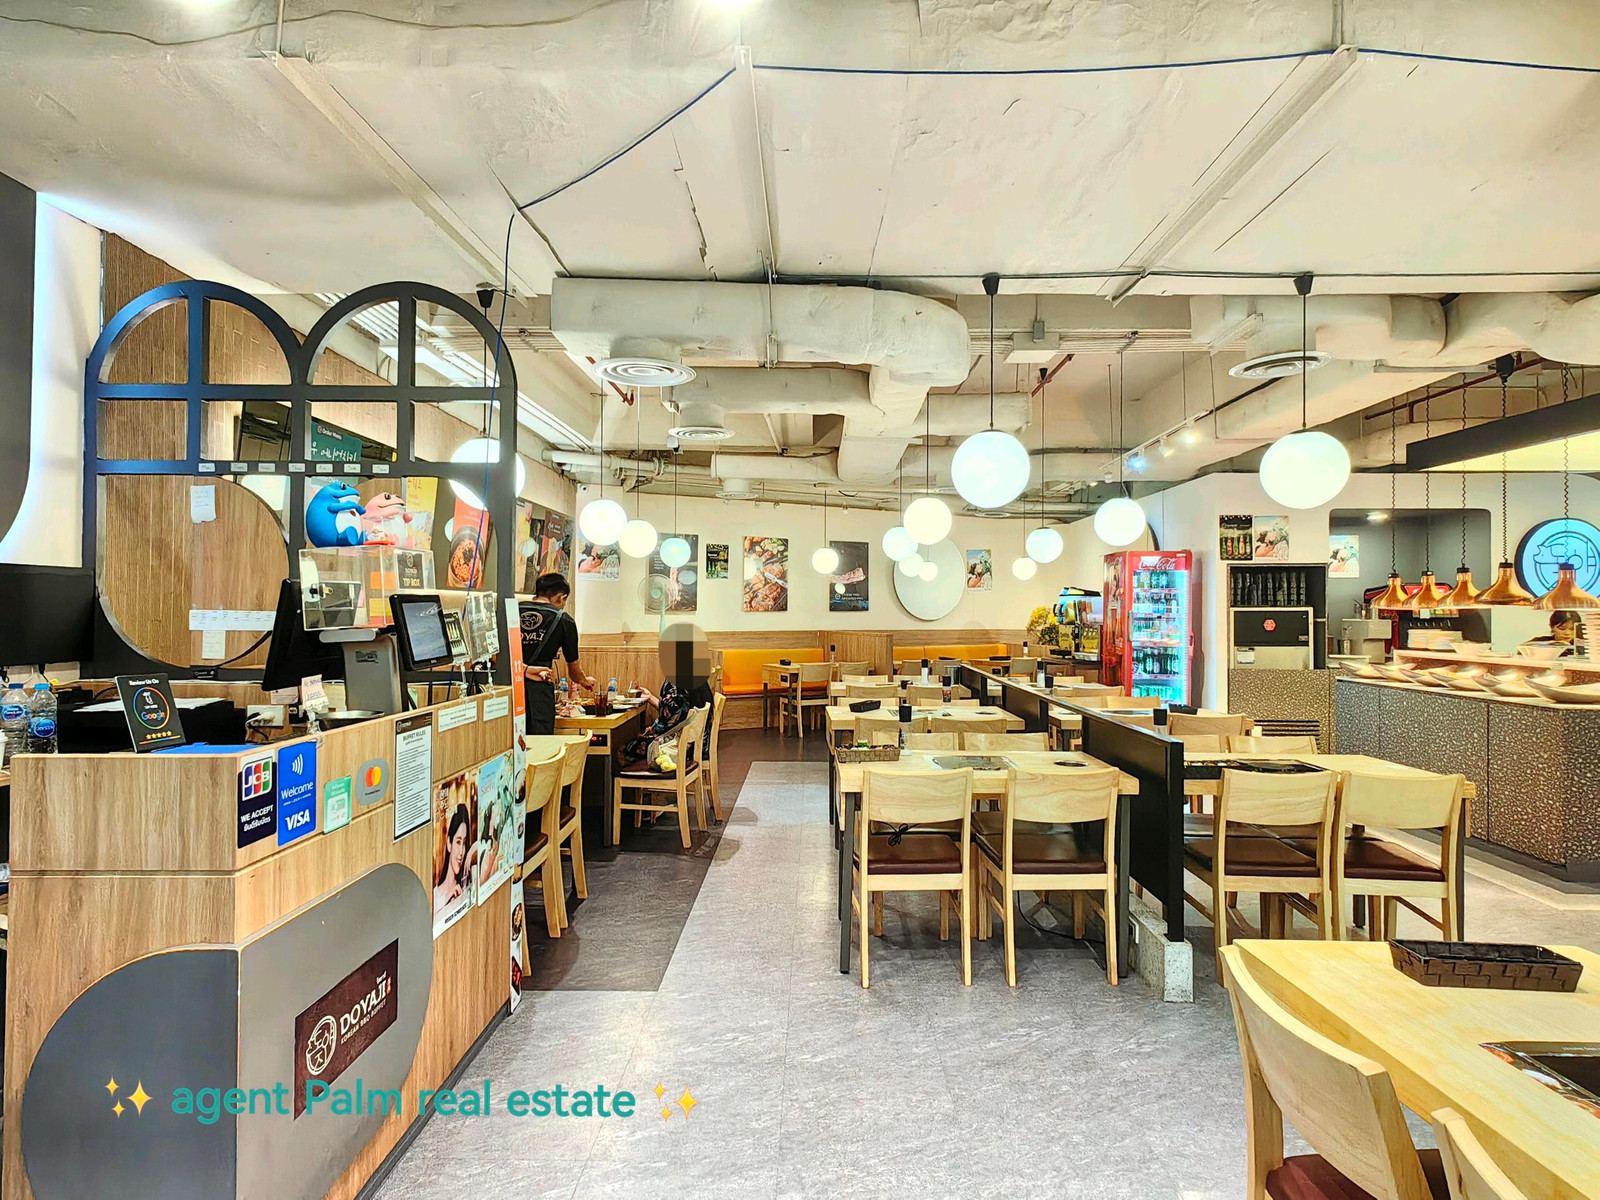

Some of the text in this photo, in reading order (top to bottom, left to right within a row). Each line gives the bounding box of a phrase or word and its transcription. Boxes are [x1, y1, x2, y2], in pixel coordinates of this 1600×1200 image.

[411, 578, 421, 587] BOX
[141, 711, 165, 720] Google
[243, 770, 270, 788] JCB
[281, 781, 314, 800] Welcome
[240, 804, 274, 824] WE ACCEPT
[285, 808, 311, 831] VISA
[340, 980, 387, 1035] DOYAJI
[341, 998, 387, 1045] KOREAN BBQ BUFFET
